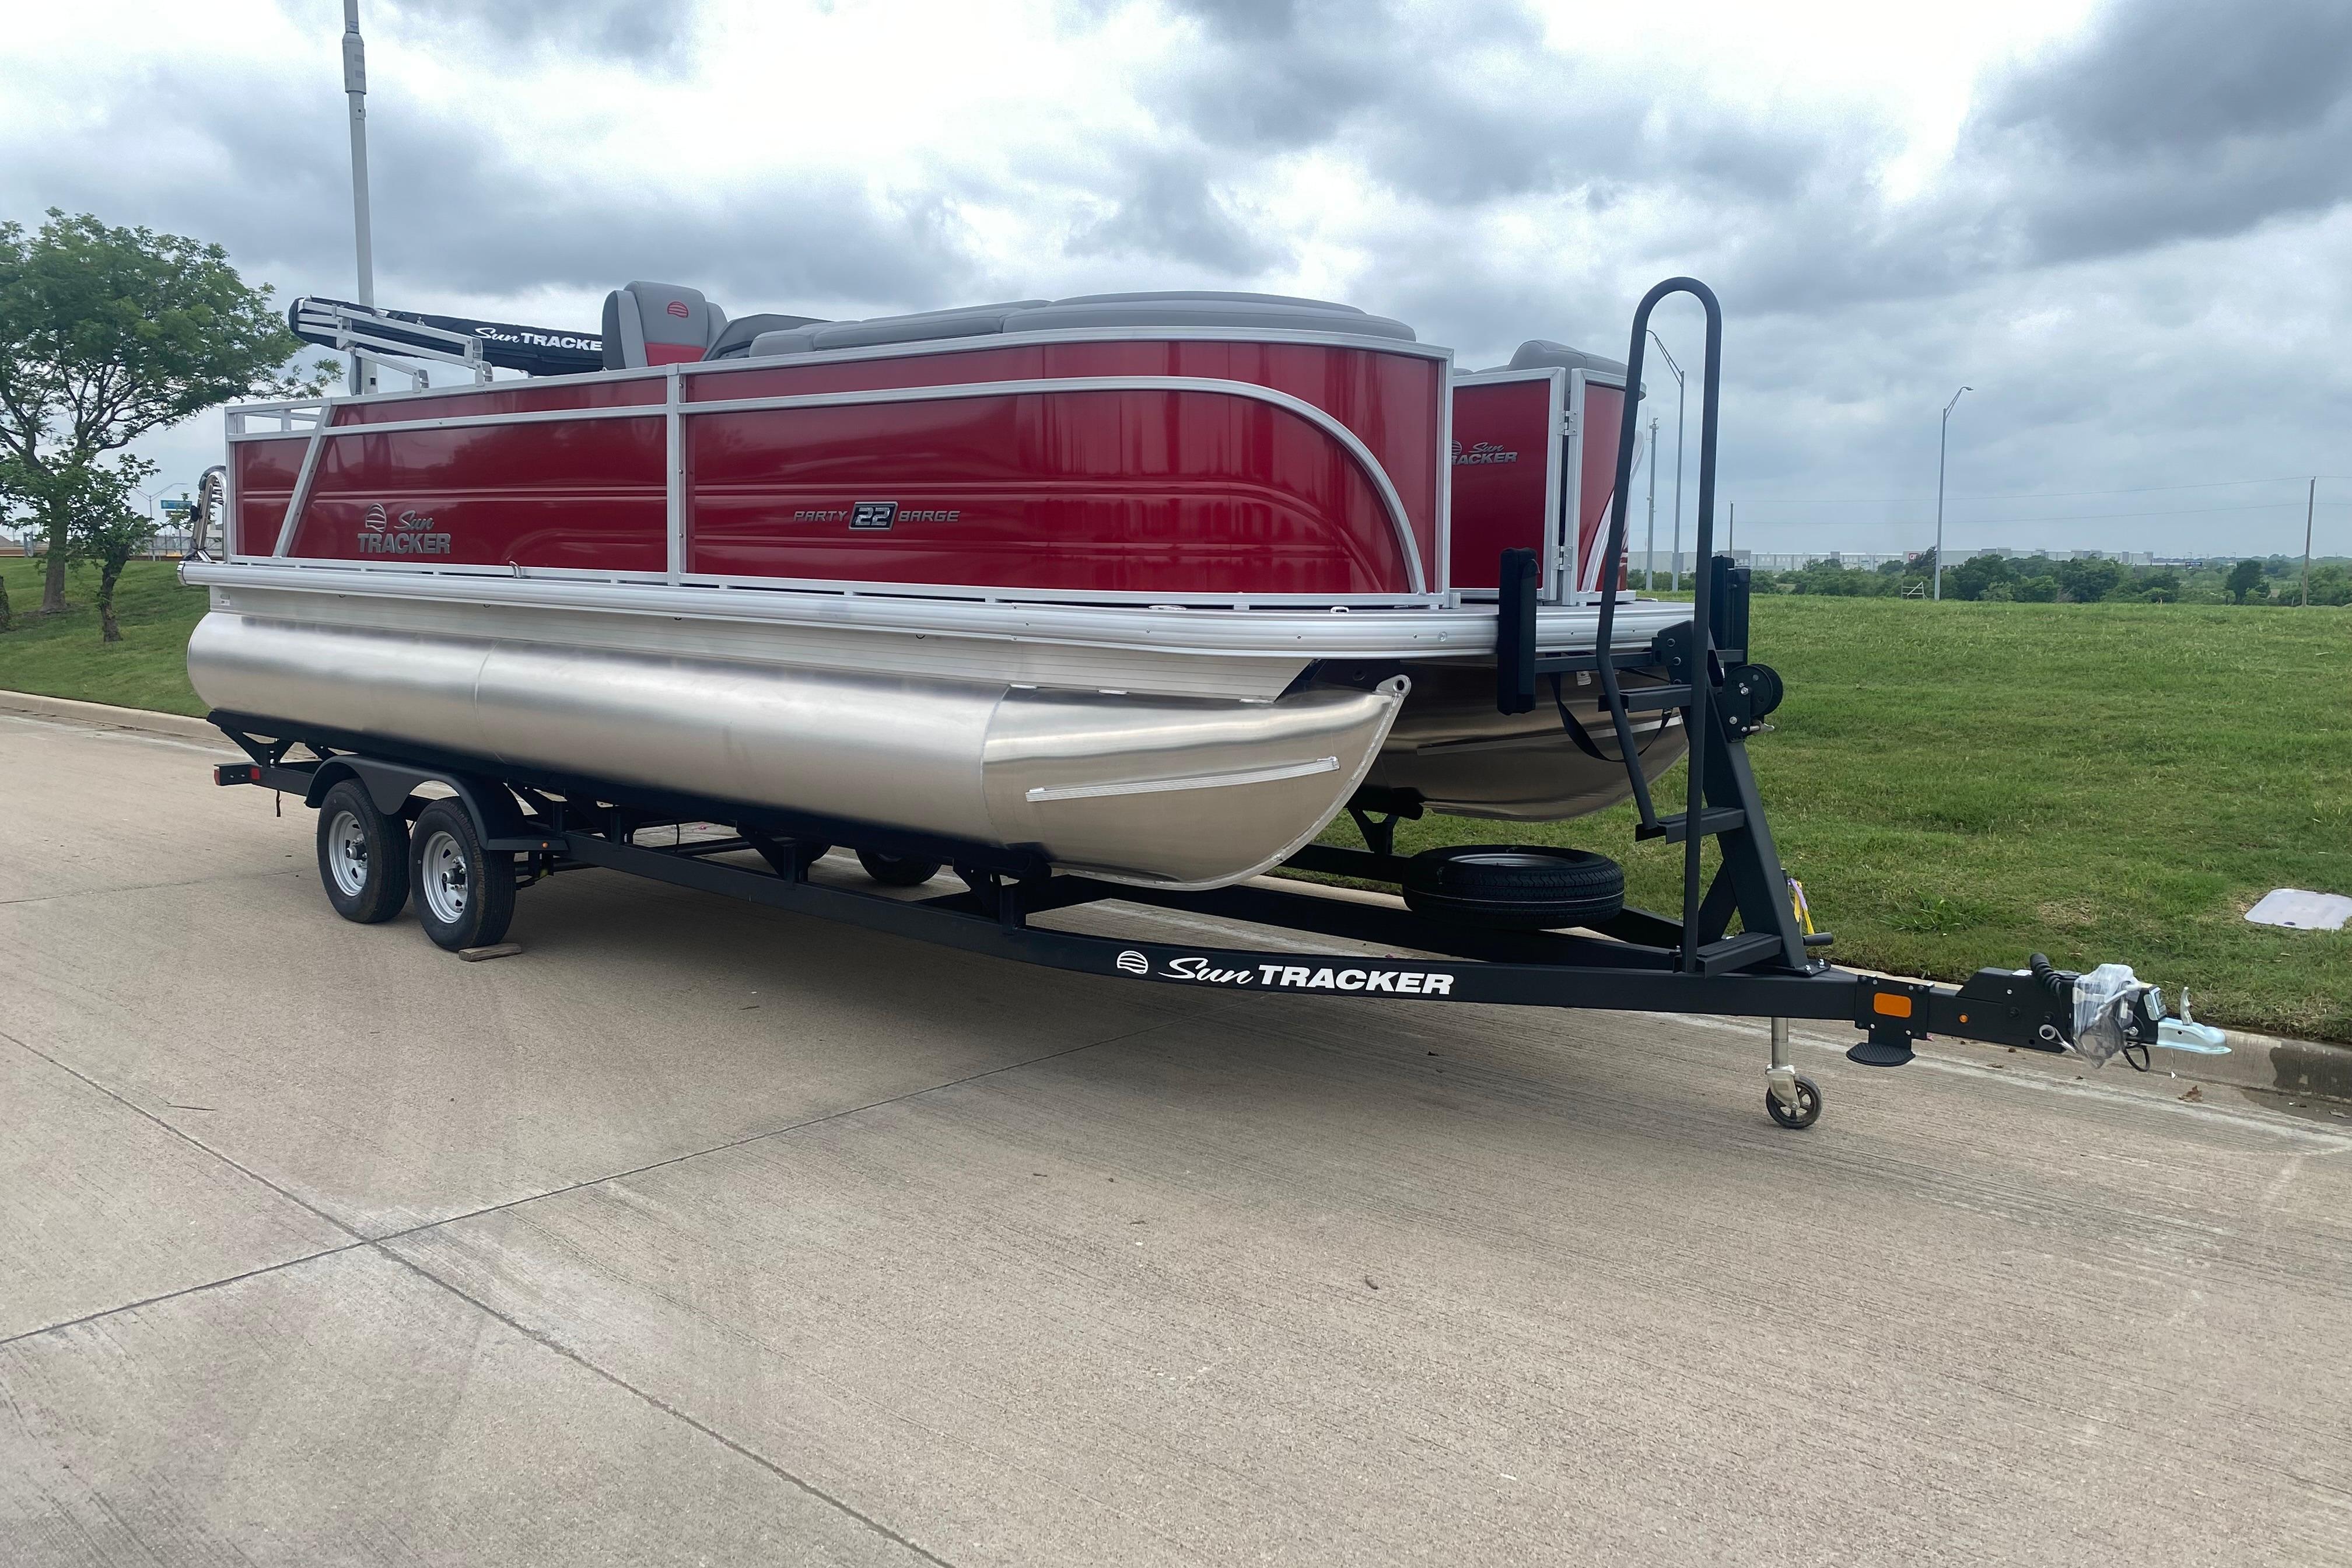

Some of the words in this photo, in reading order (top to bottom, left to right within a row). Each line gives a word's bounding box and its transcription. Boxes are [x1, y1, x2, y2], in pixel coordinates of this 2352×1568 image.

[470, 327, 520, 343] Sun
[521, 332, 602, 351] TRACKE
[1468, 442, 1504, 453] Sun
[393, 510, 435, 531] Sun
[793, 510, 848, 522] PARTY
[854, 507, 890, 526] 22
[898, 510, 961, 522] BARGE
[357, 533, 452, 554] TRACKER
[1158, 957, 1254, 982] Sun
[1257, 964, 1454, 995] TRACKER
